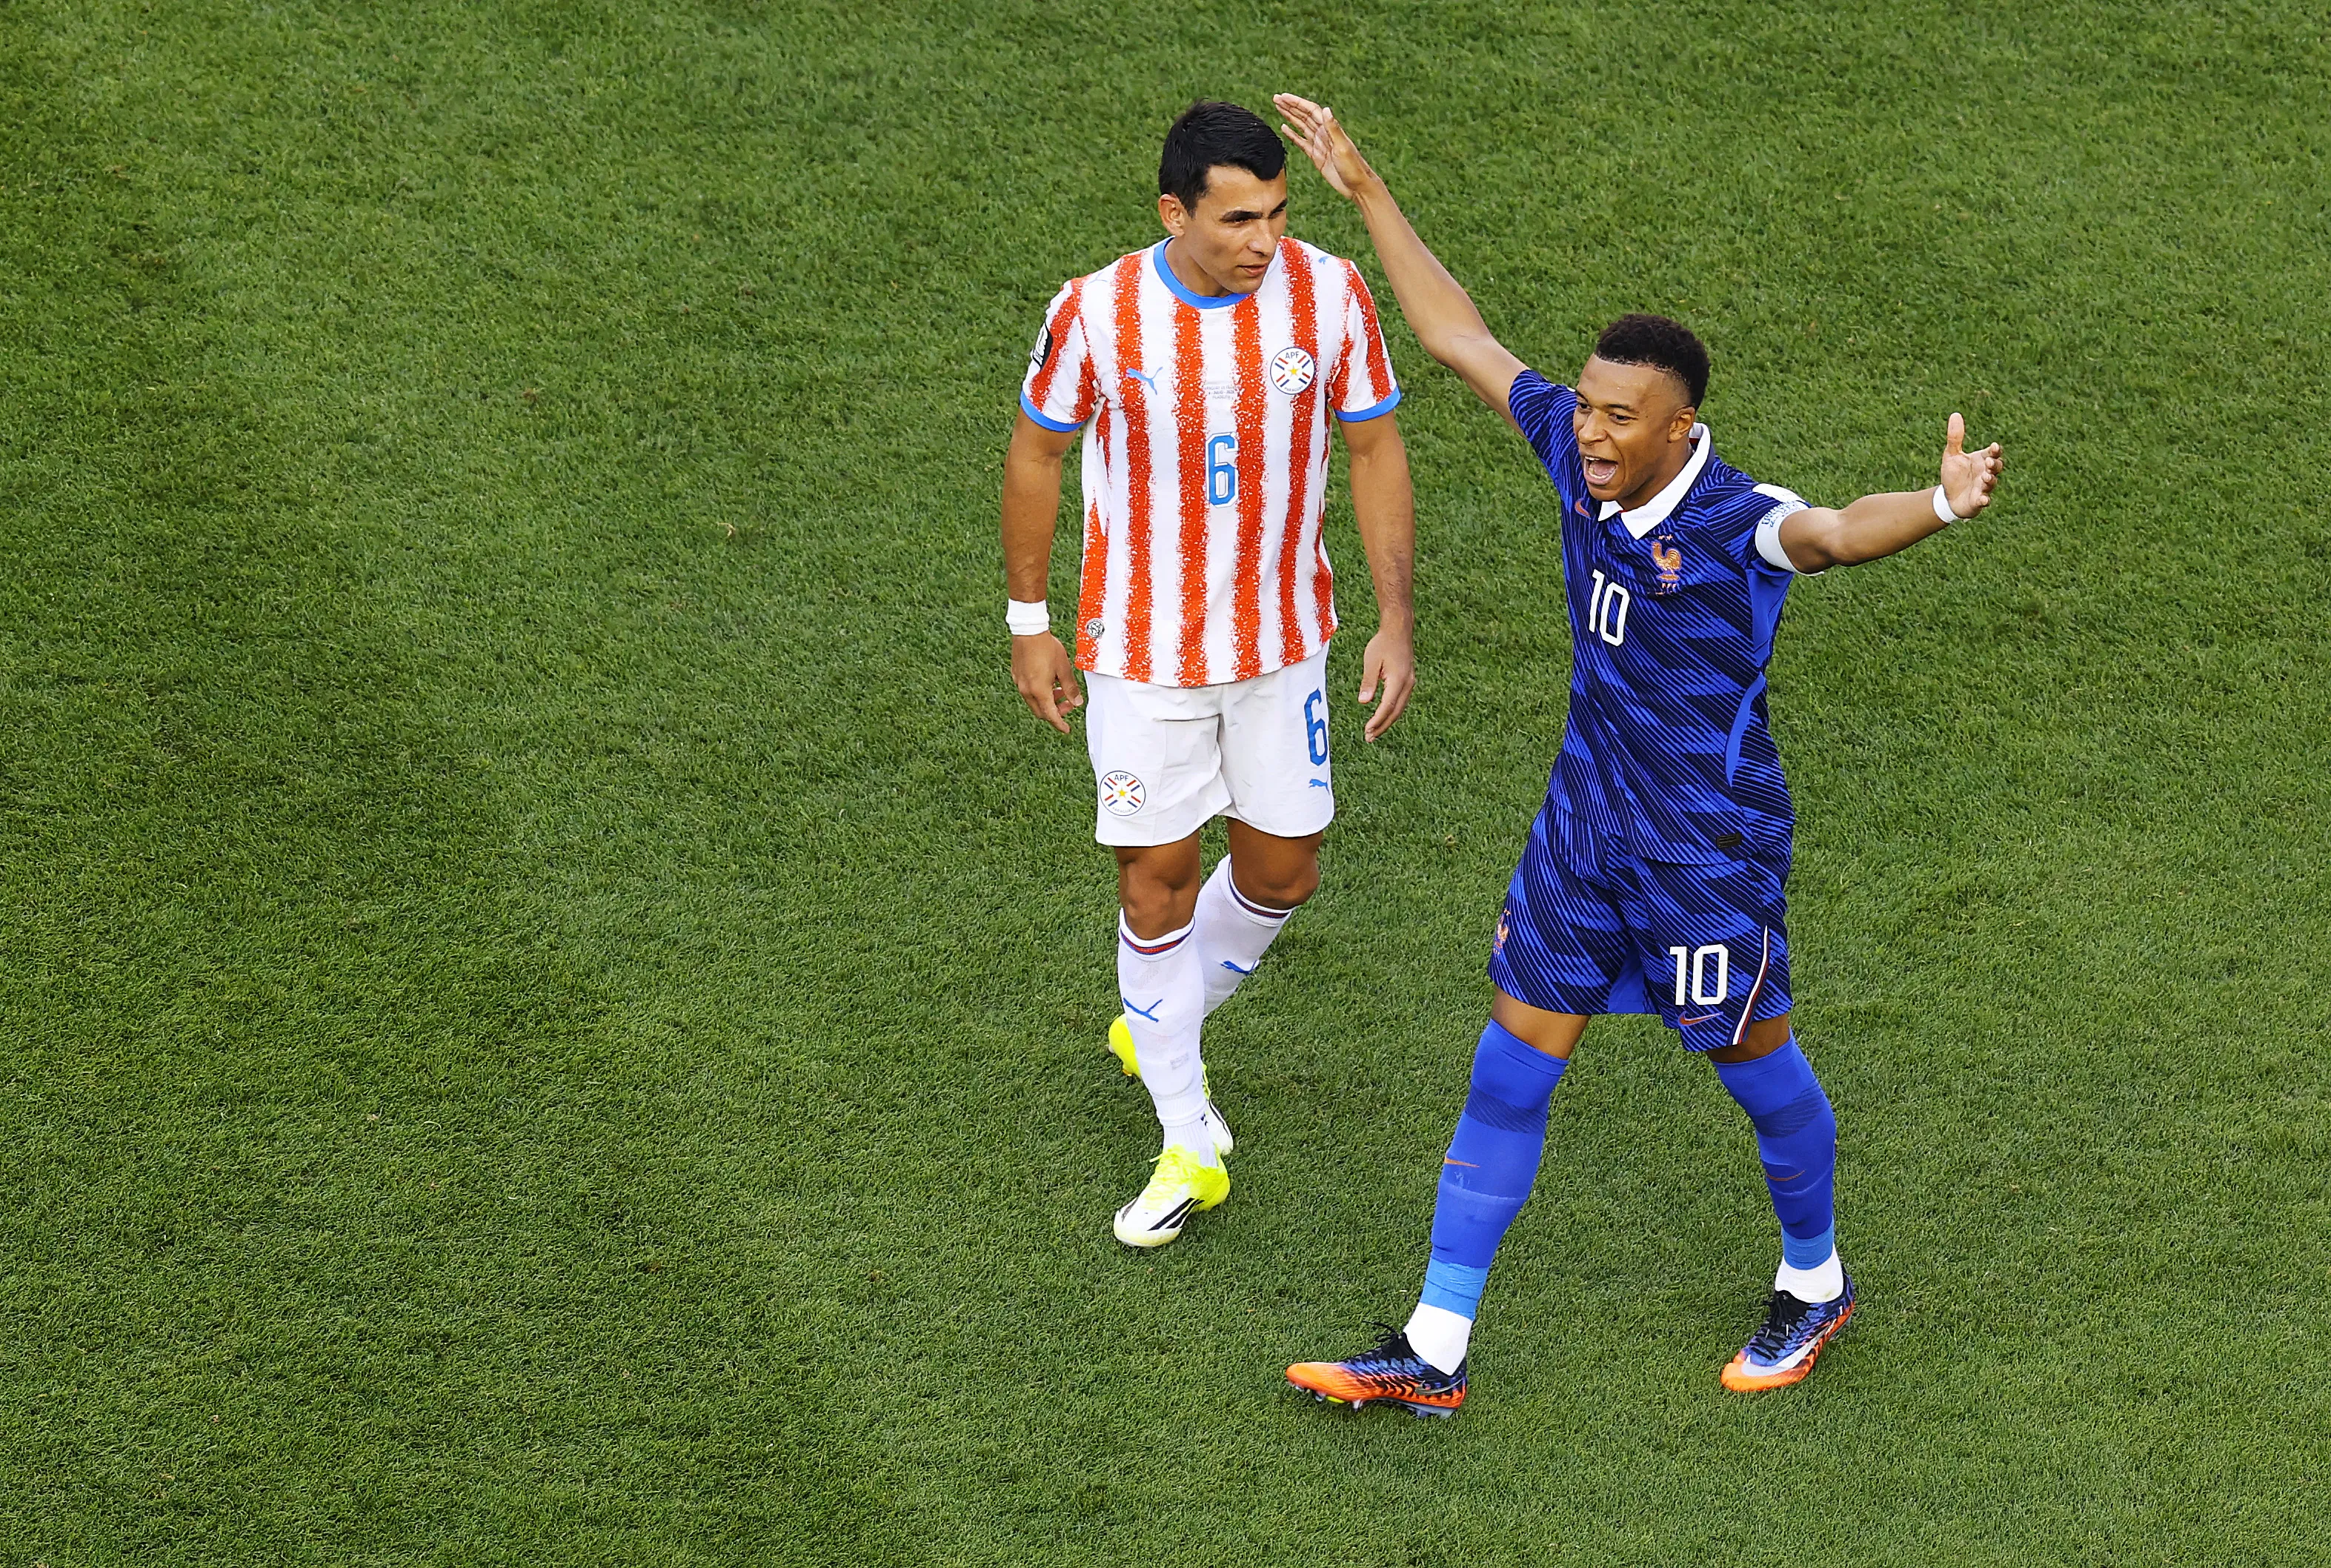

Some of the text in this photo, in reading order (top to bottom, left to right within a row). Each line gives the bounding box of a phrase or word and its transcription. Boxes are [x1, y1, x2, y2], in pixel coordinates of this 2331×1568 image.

[1285, 351, 1300, 359] APF
[1206, 431, 1240, 508] 6
[1588, 568, 1629, 647] 10
[1304, 687, 1329, 767] 6
[1114, 774, 1129, 782] APF
[1669, 943, 1729, 1006] 10
